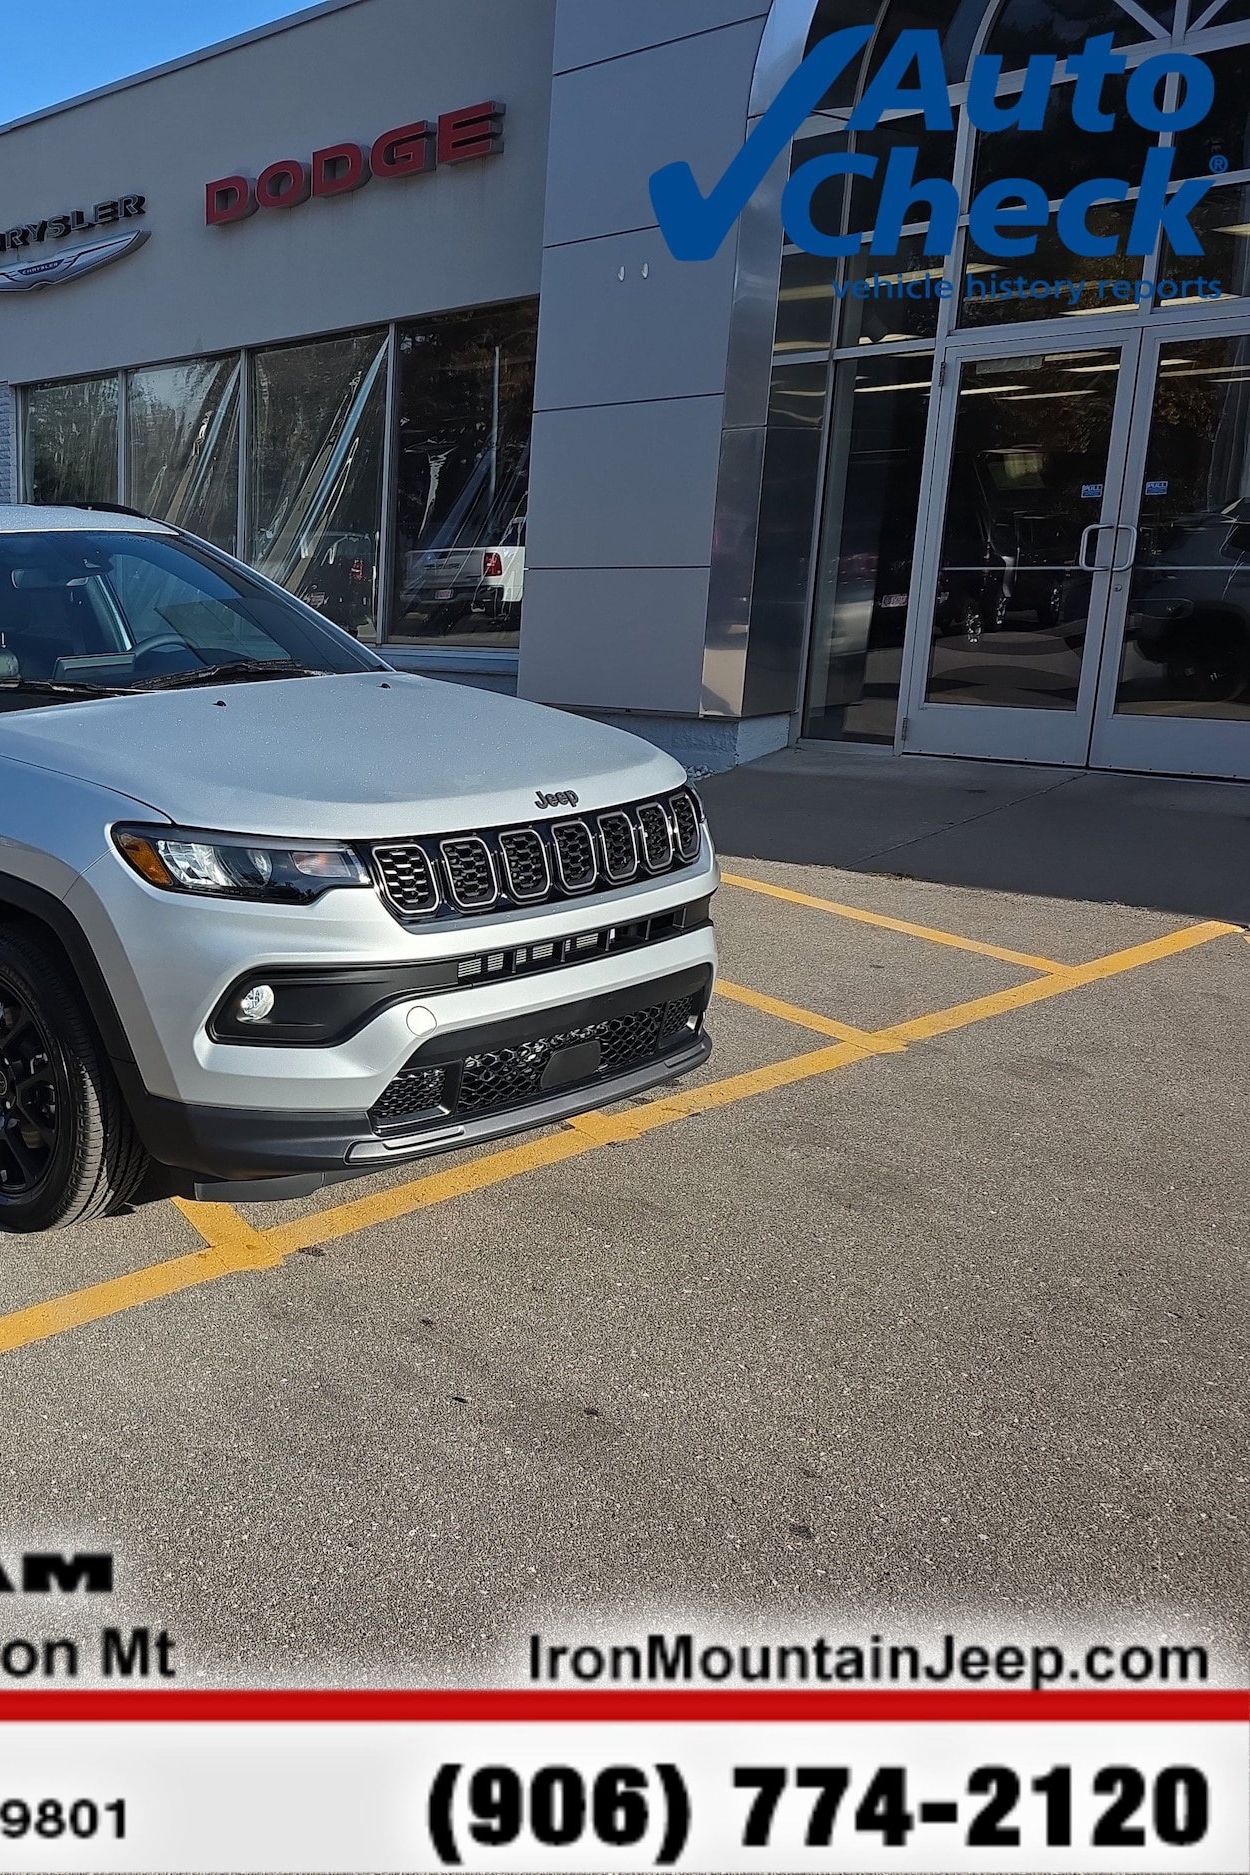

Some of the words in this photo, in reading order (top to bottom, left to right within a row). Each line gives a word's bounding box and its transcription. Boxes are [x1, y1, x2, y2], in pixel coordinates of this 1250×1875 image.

[205, 100, 506, 226] DODGE
[21, 261, 60, 275] CHRYSLER
[534, 789, 579, 809] Jeep
